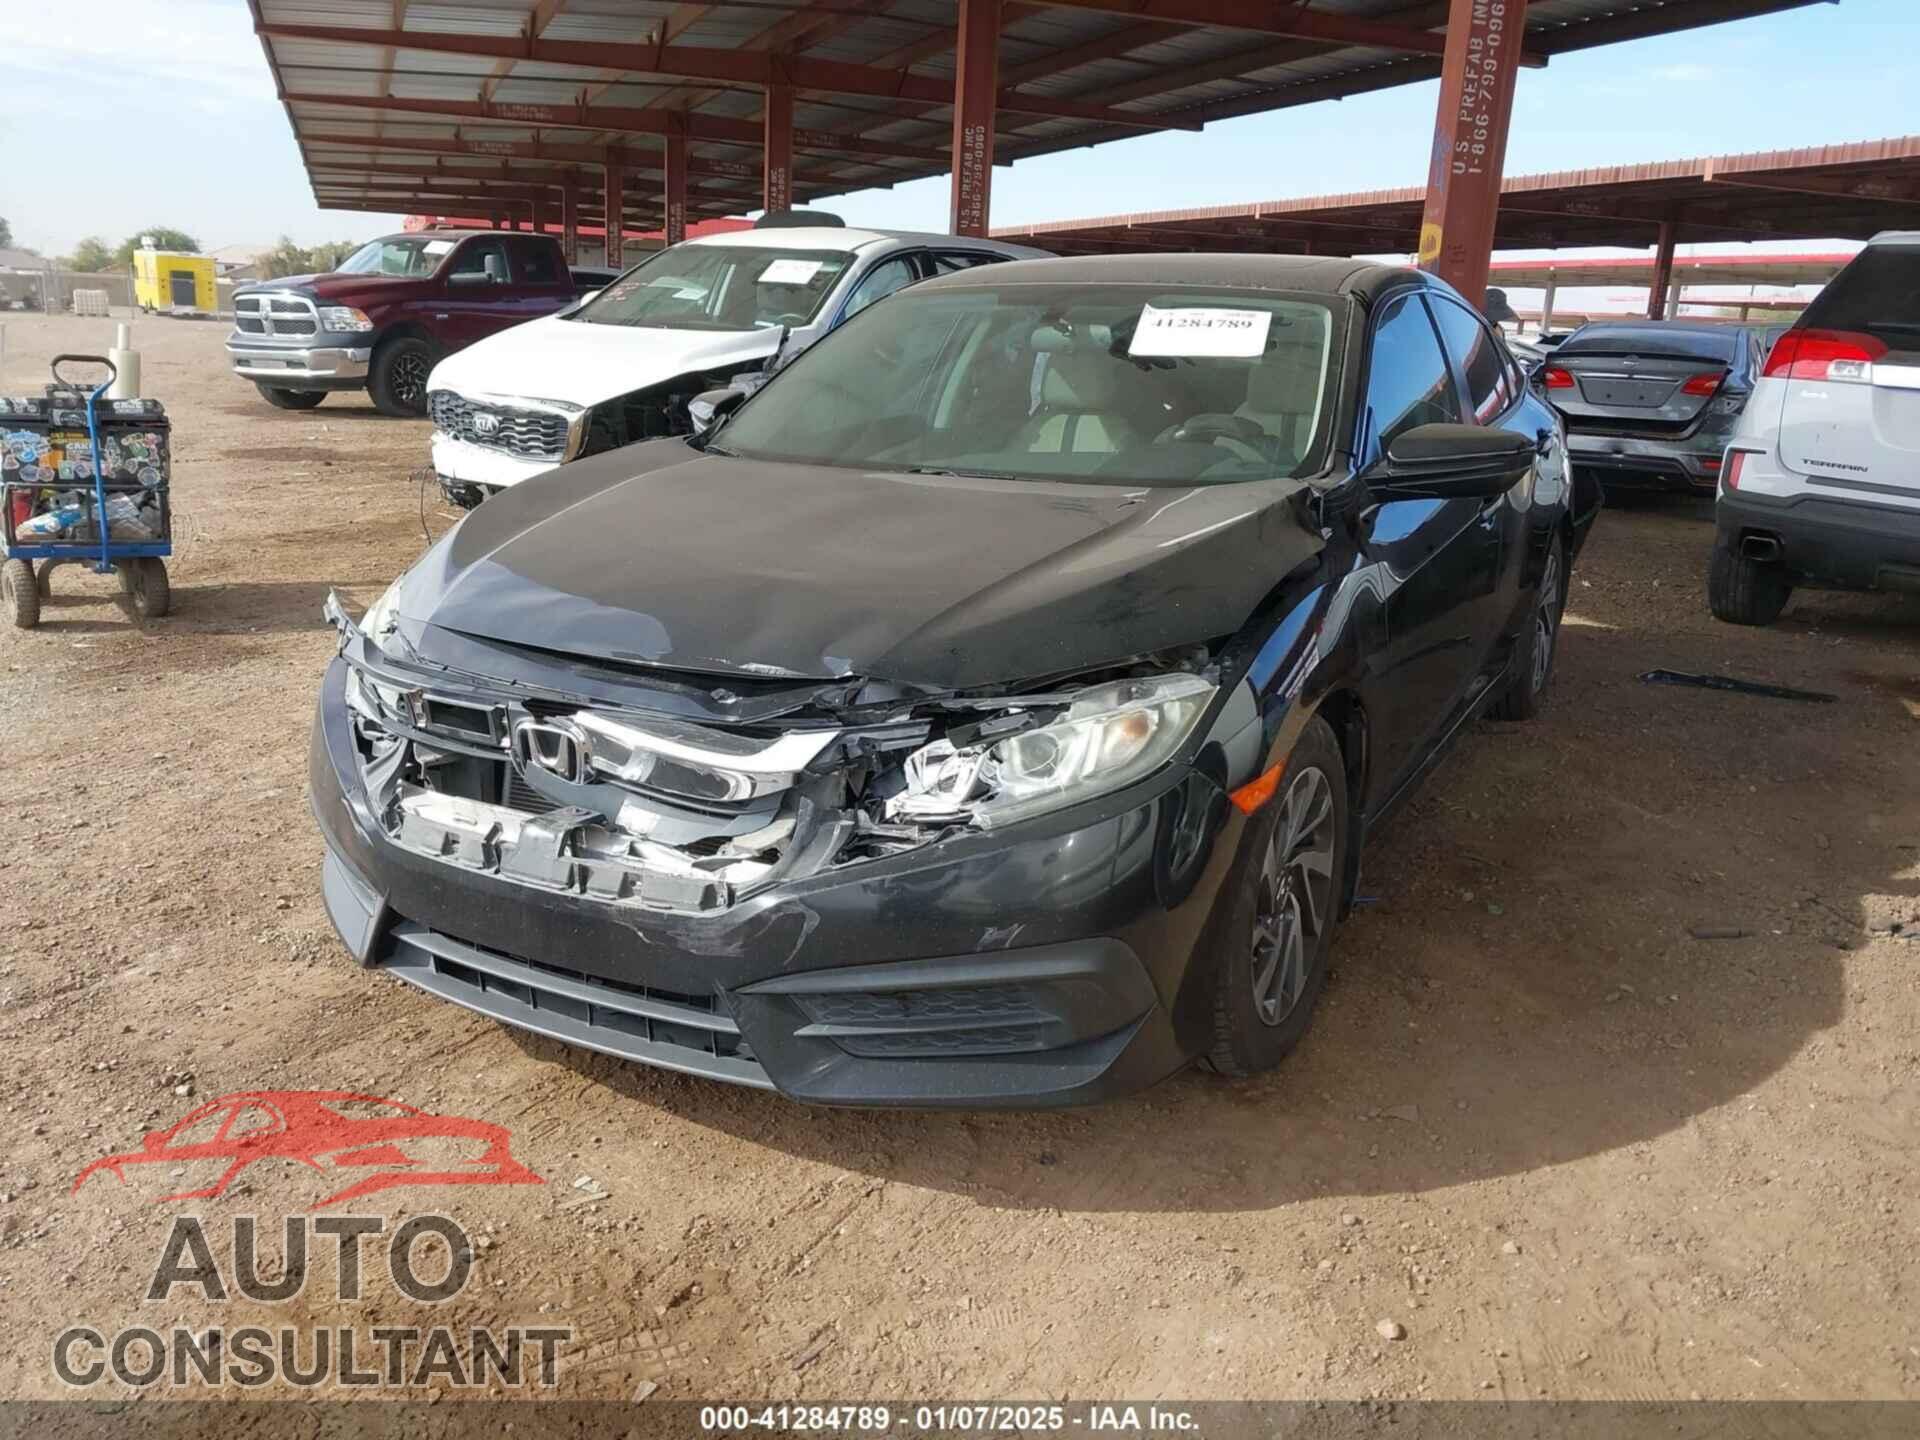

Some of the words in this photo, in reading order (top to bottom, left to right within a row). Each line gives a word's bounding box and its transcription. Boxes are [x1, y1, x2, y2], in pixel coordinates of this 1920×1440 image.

[1459, 38, 1484, 122] PREFAB
[1468, 0, 1504, 174] 1-866-799-096
[961, 153, 974, 200] PREFAB
[1452, 135, 1470, 175] U.S.
[1152, 318, 1253, 329] 41284789
[1801, 458, 1869, 473] TERRAIN
